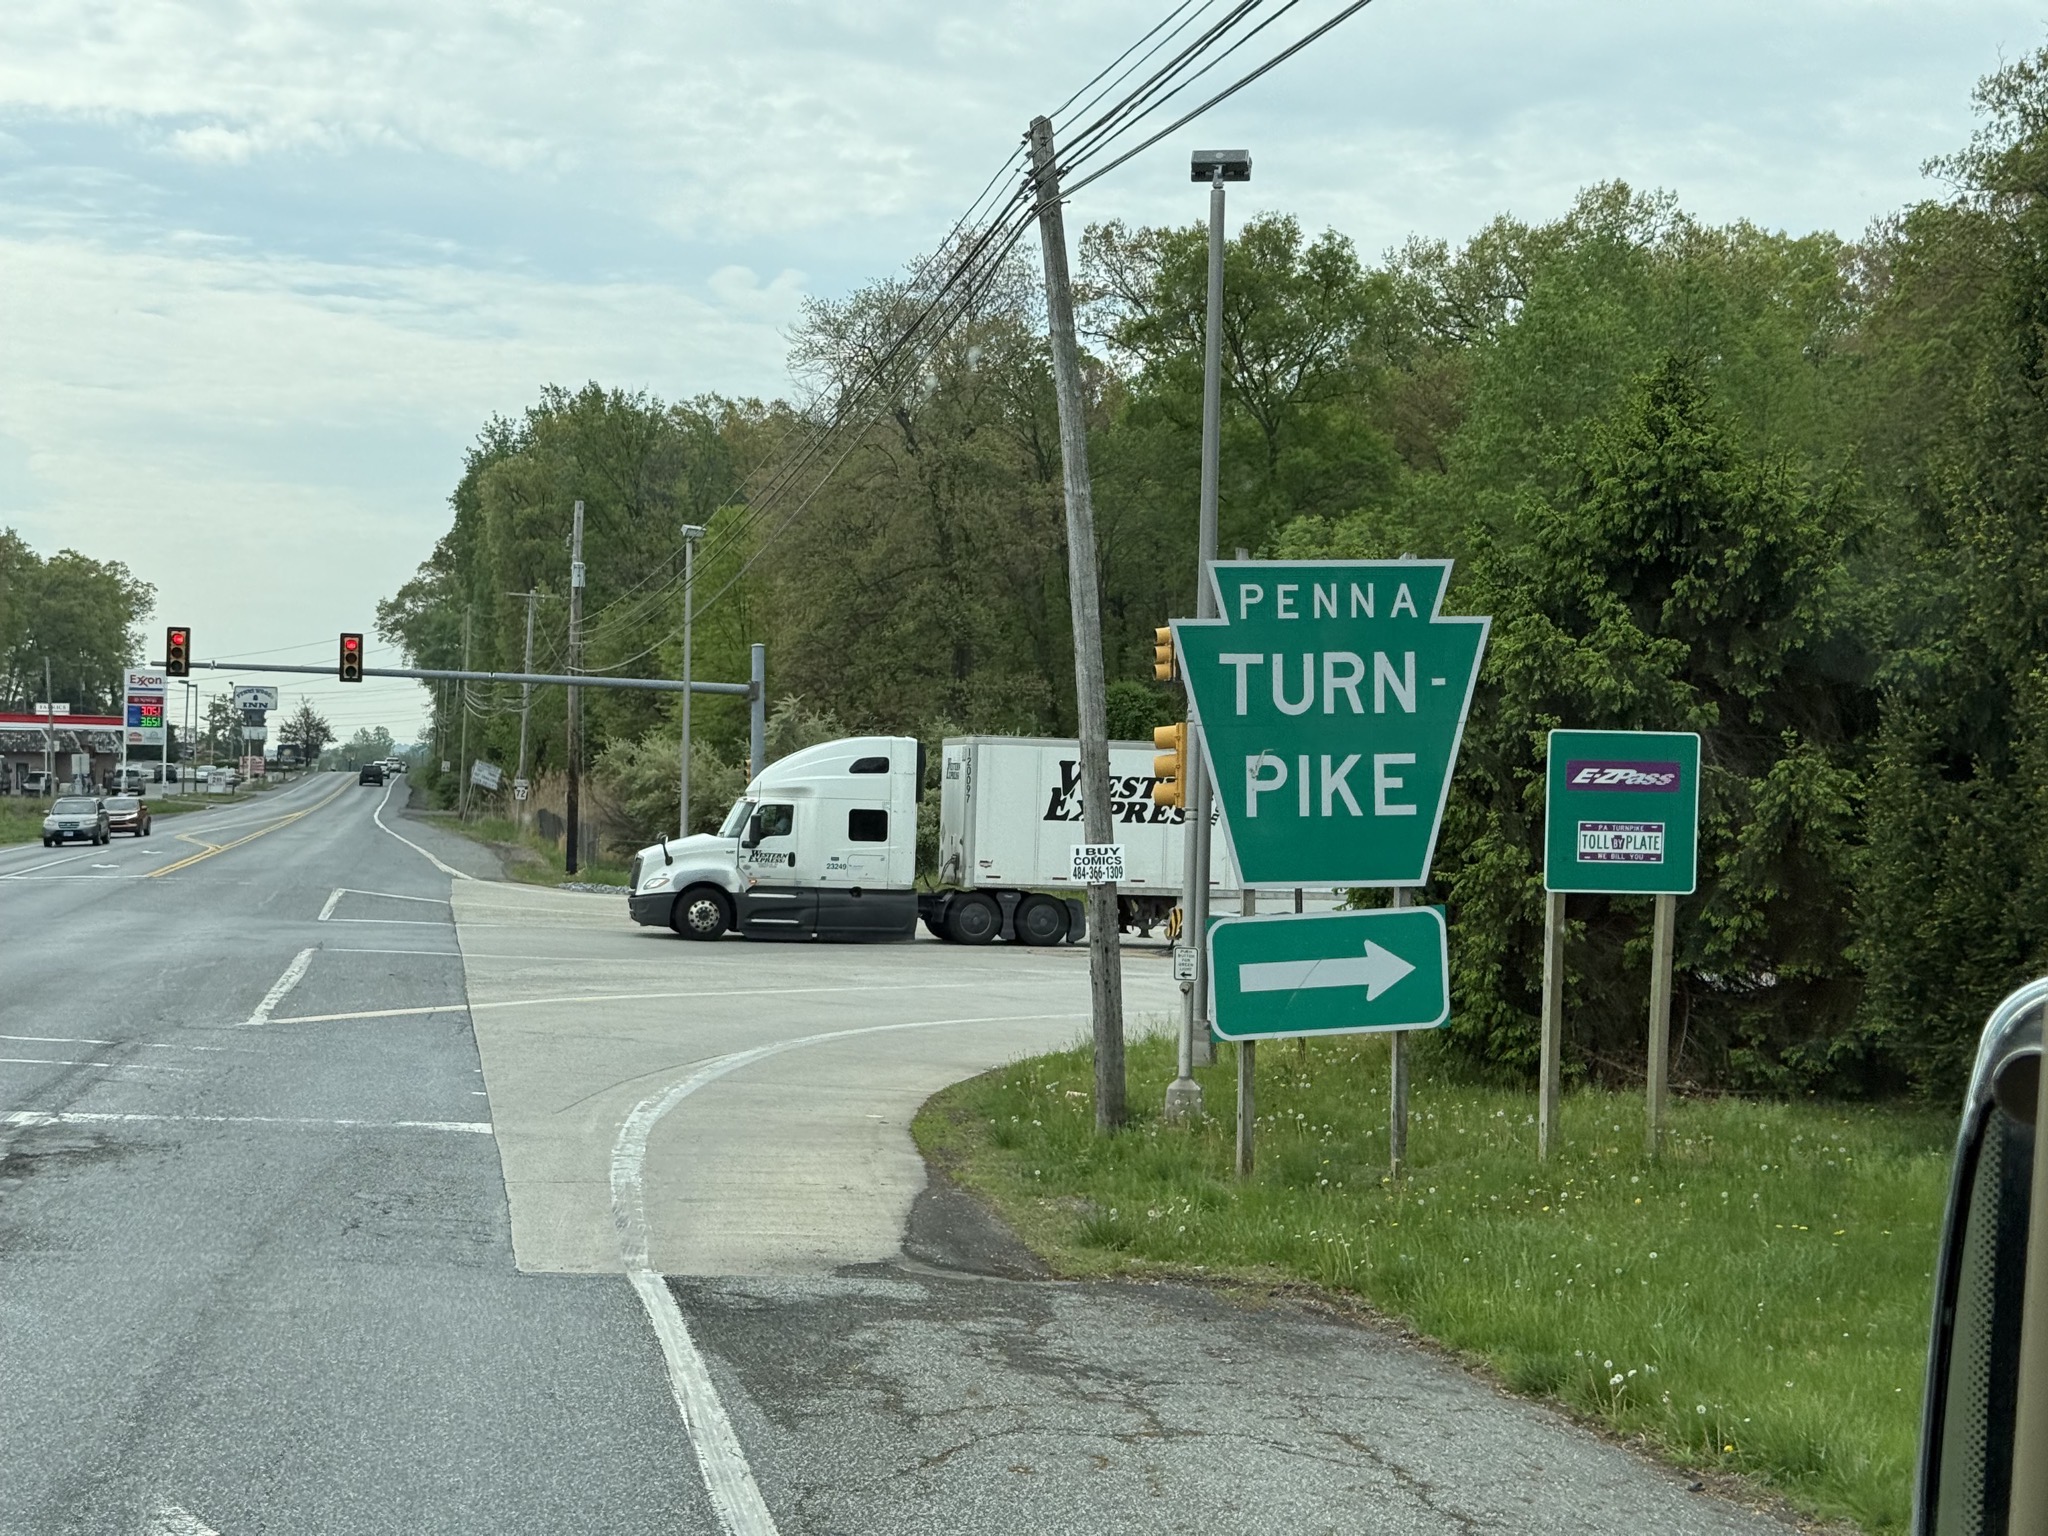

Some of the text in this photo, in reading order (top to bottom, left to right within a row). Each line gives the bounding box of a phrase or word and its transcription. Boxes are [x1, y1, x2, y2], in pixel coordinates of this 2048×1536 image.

[130, 674, 162, 687] Exxon
[1219, 651, 1446, 716] TURN-
[1245, 753, 1417, 817] PIKE
[516, 789, 526, 798] 72
[1582, 834, 1660, 850] TOLL BY PLATE
[751, 850, 788, 859] WESTERN
[1075, 847, 1120, 856] I BUY
[1073, 856, 1122, 866] COMICS
[1073, 865, 1123, 880] 484-366-1309
